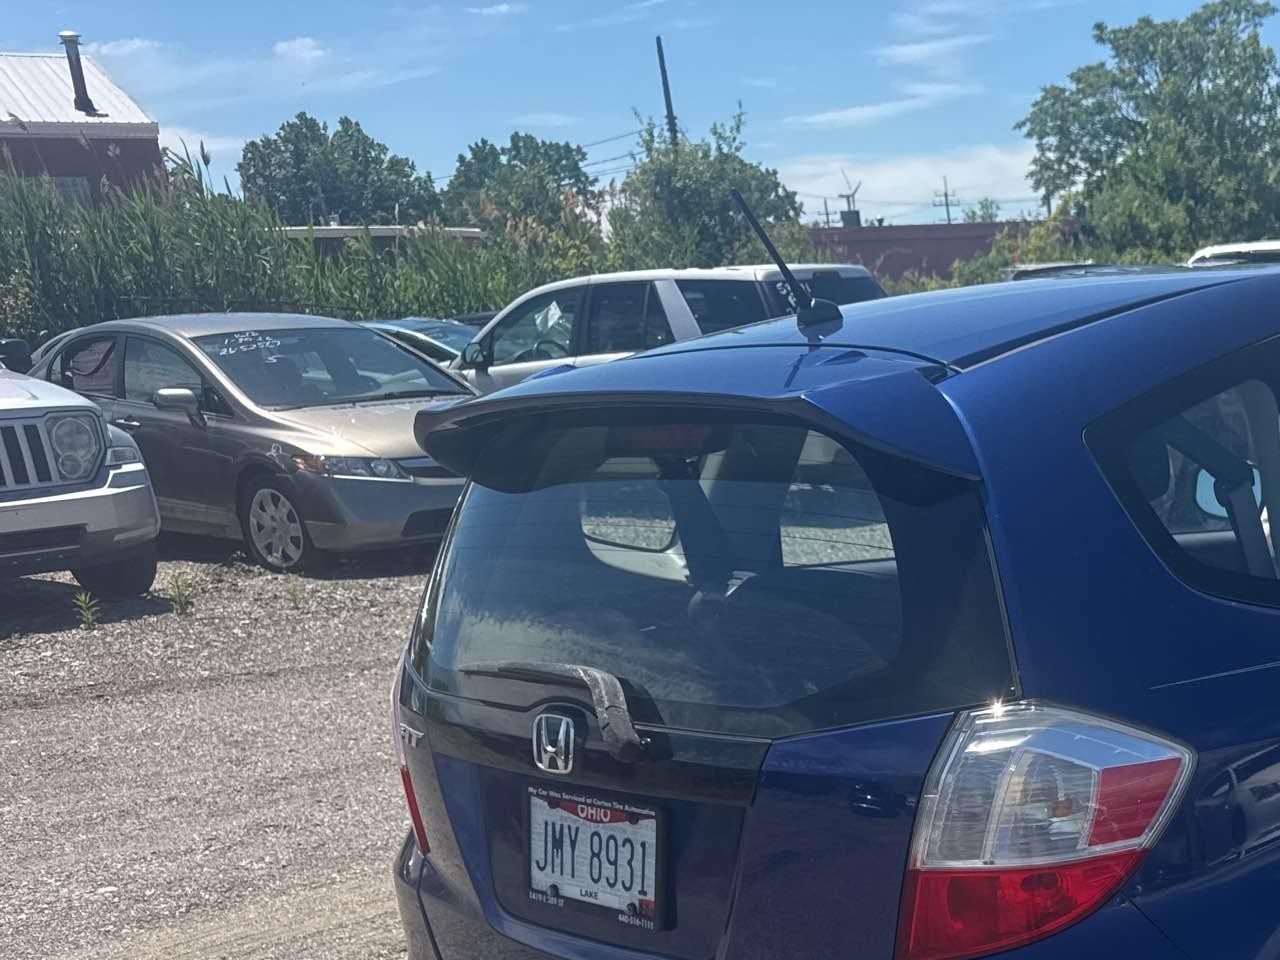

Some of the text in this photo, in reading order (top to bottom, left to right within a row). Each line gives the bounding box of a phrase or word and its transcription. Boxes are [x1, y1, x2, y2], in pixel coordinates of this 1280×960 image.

[577, 804, 611, 822] OHIO
[535, 820, 648, 897] JMY 8931
[579, 888, 599, 900] LAKE
